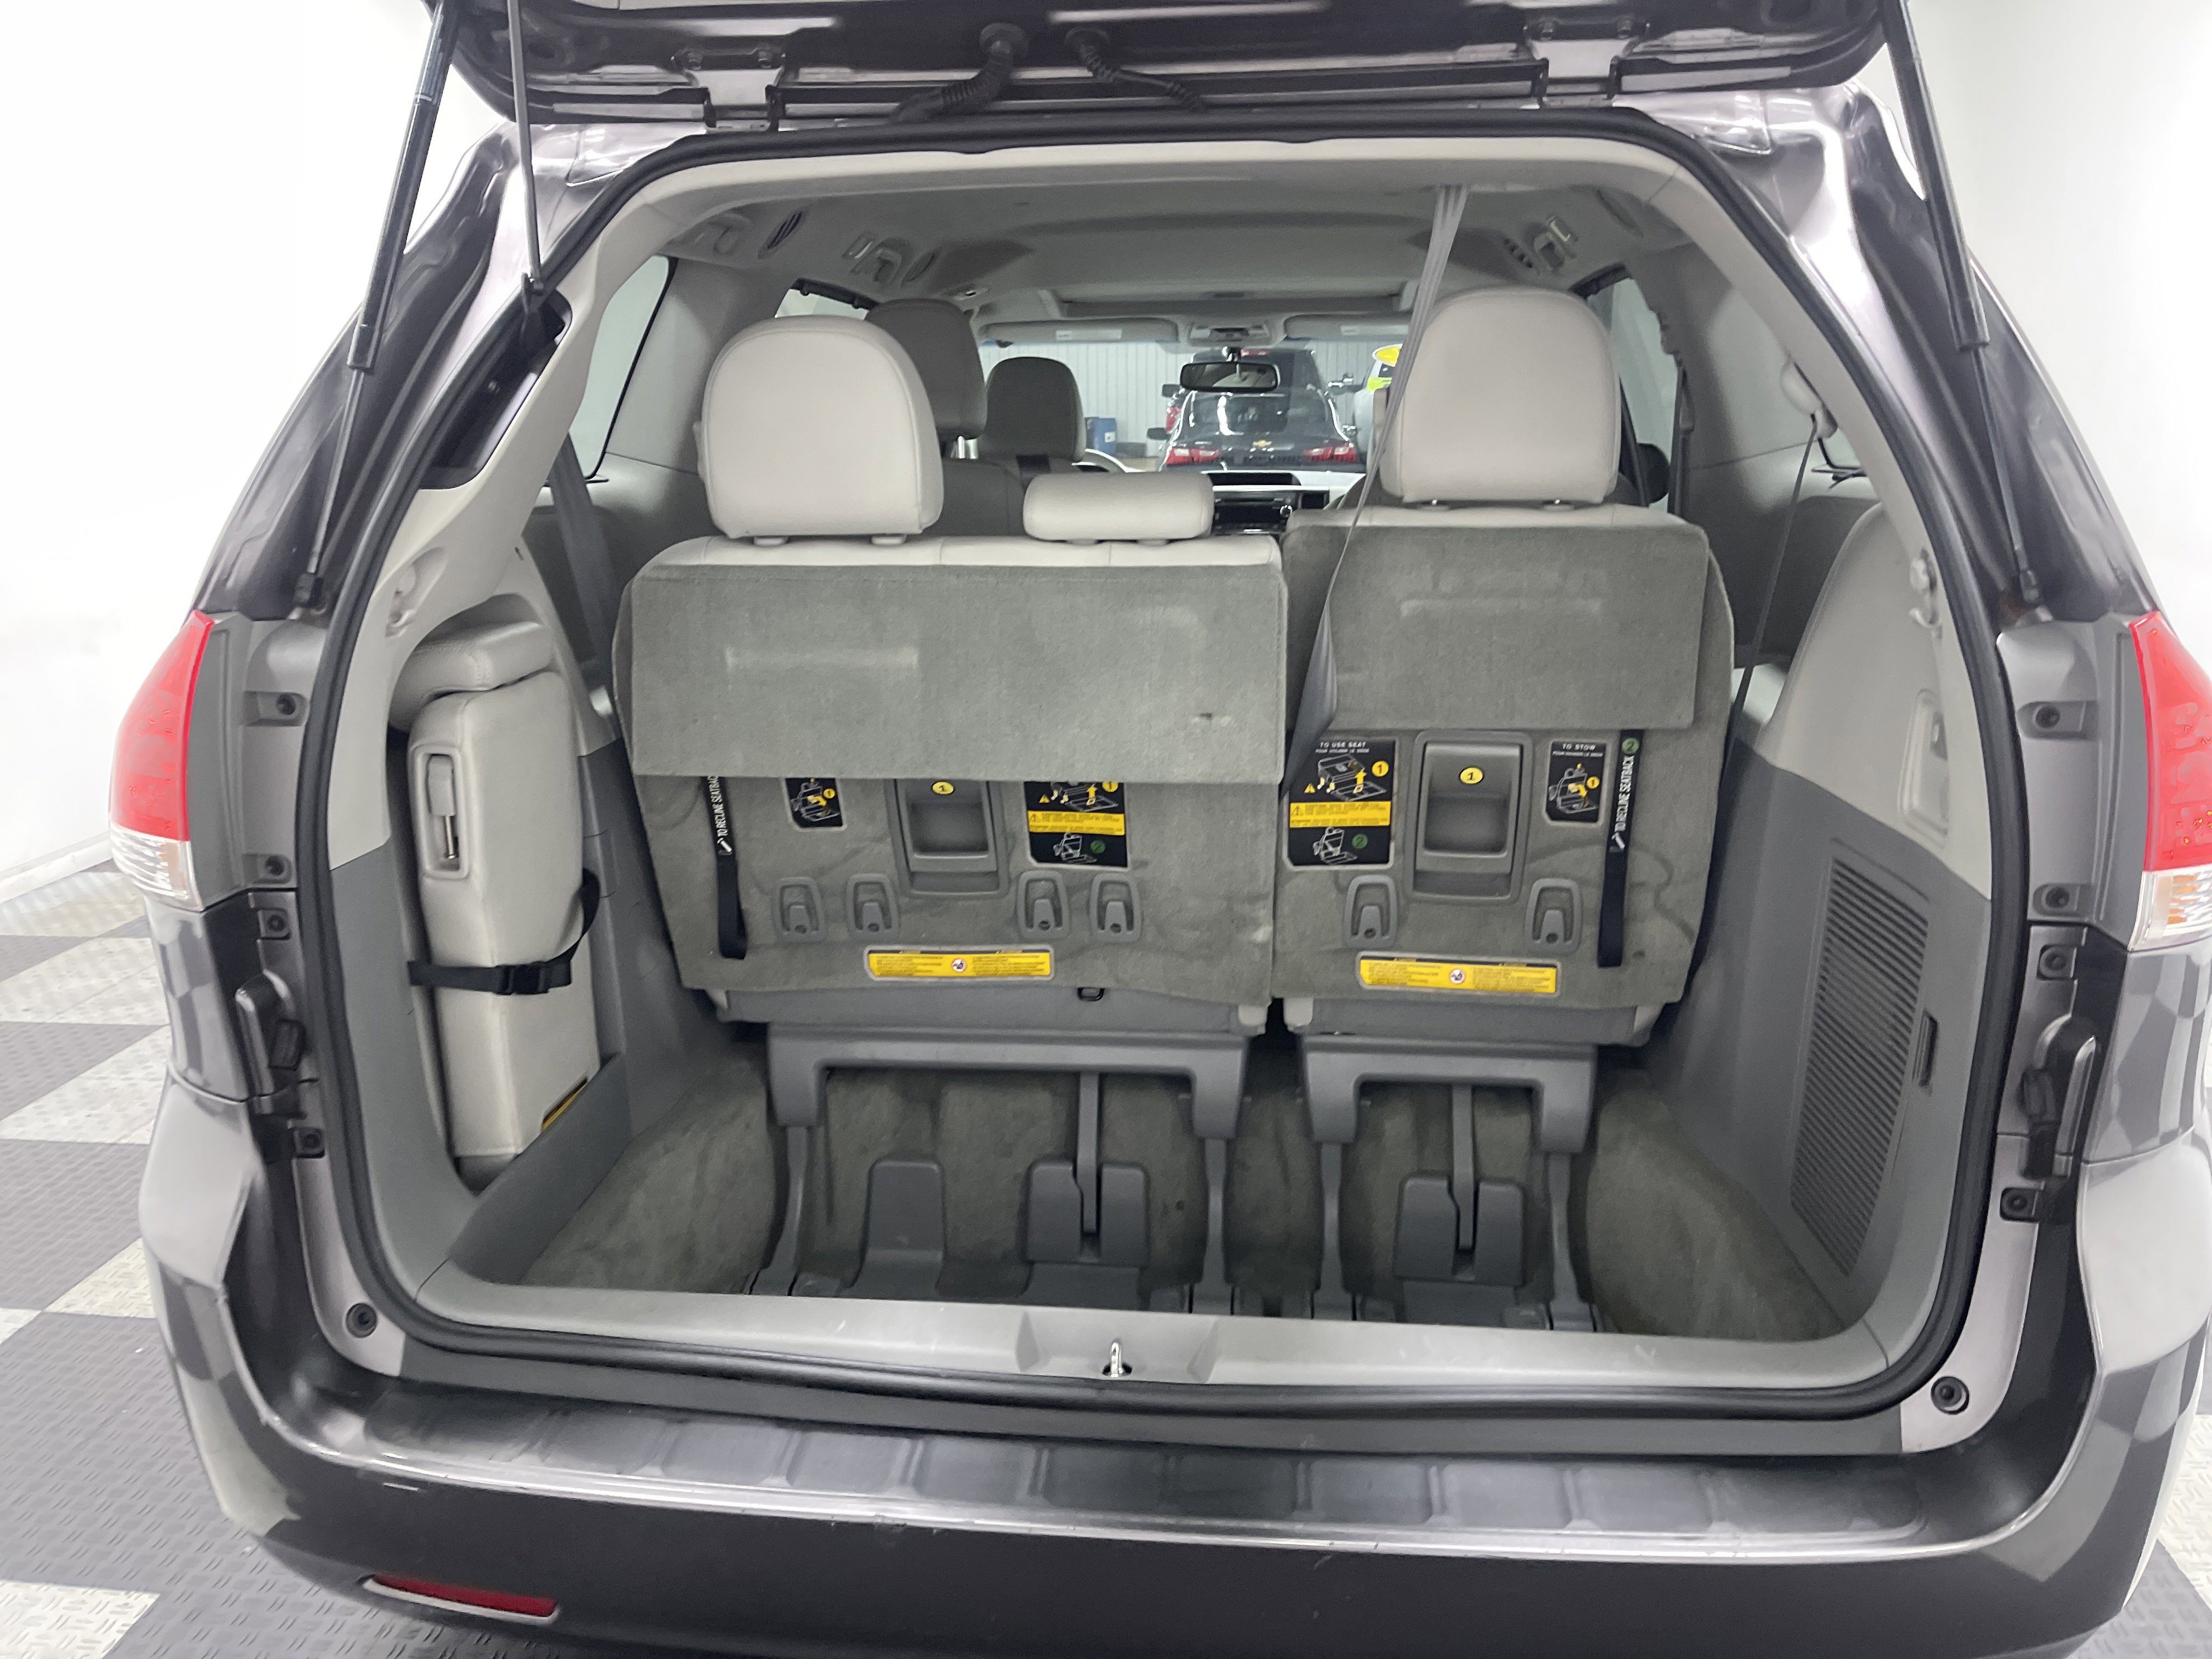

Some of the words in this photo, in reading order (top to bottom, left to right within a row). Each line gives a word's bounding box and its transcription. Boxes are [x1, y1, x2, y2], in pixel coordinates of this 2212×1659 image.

[1619, 755, 1635, 792] SEATBACK
[707, 775, 723, 803] SEATBAC
[1616, 793, 1630, 822] RECLINE
[717, 828, 729, 837] TO
[1615, 822, 1626, 832] TO
